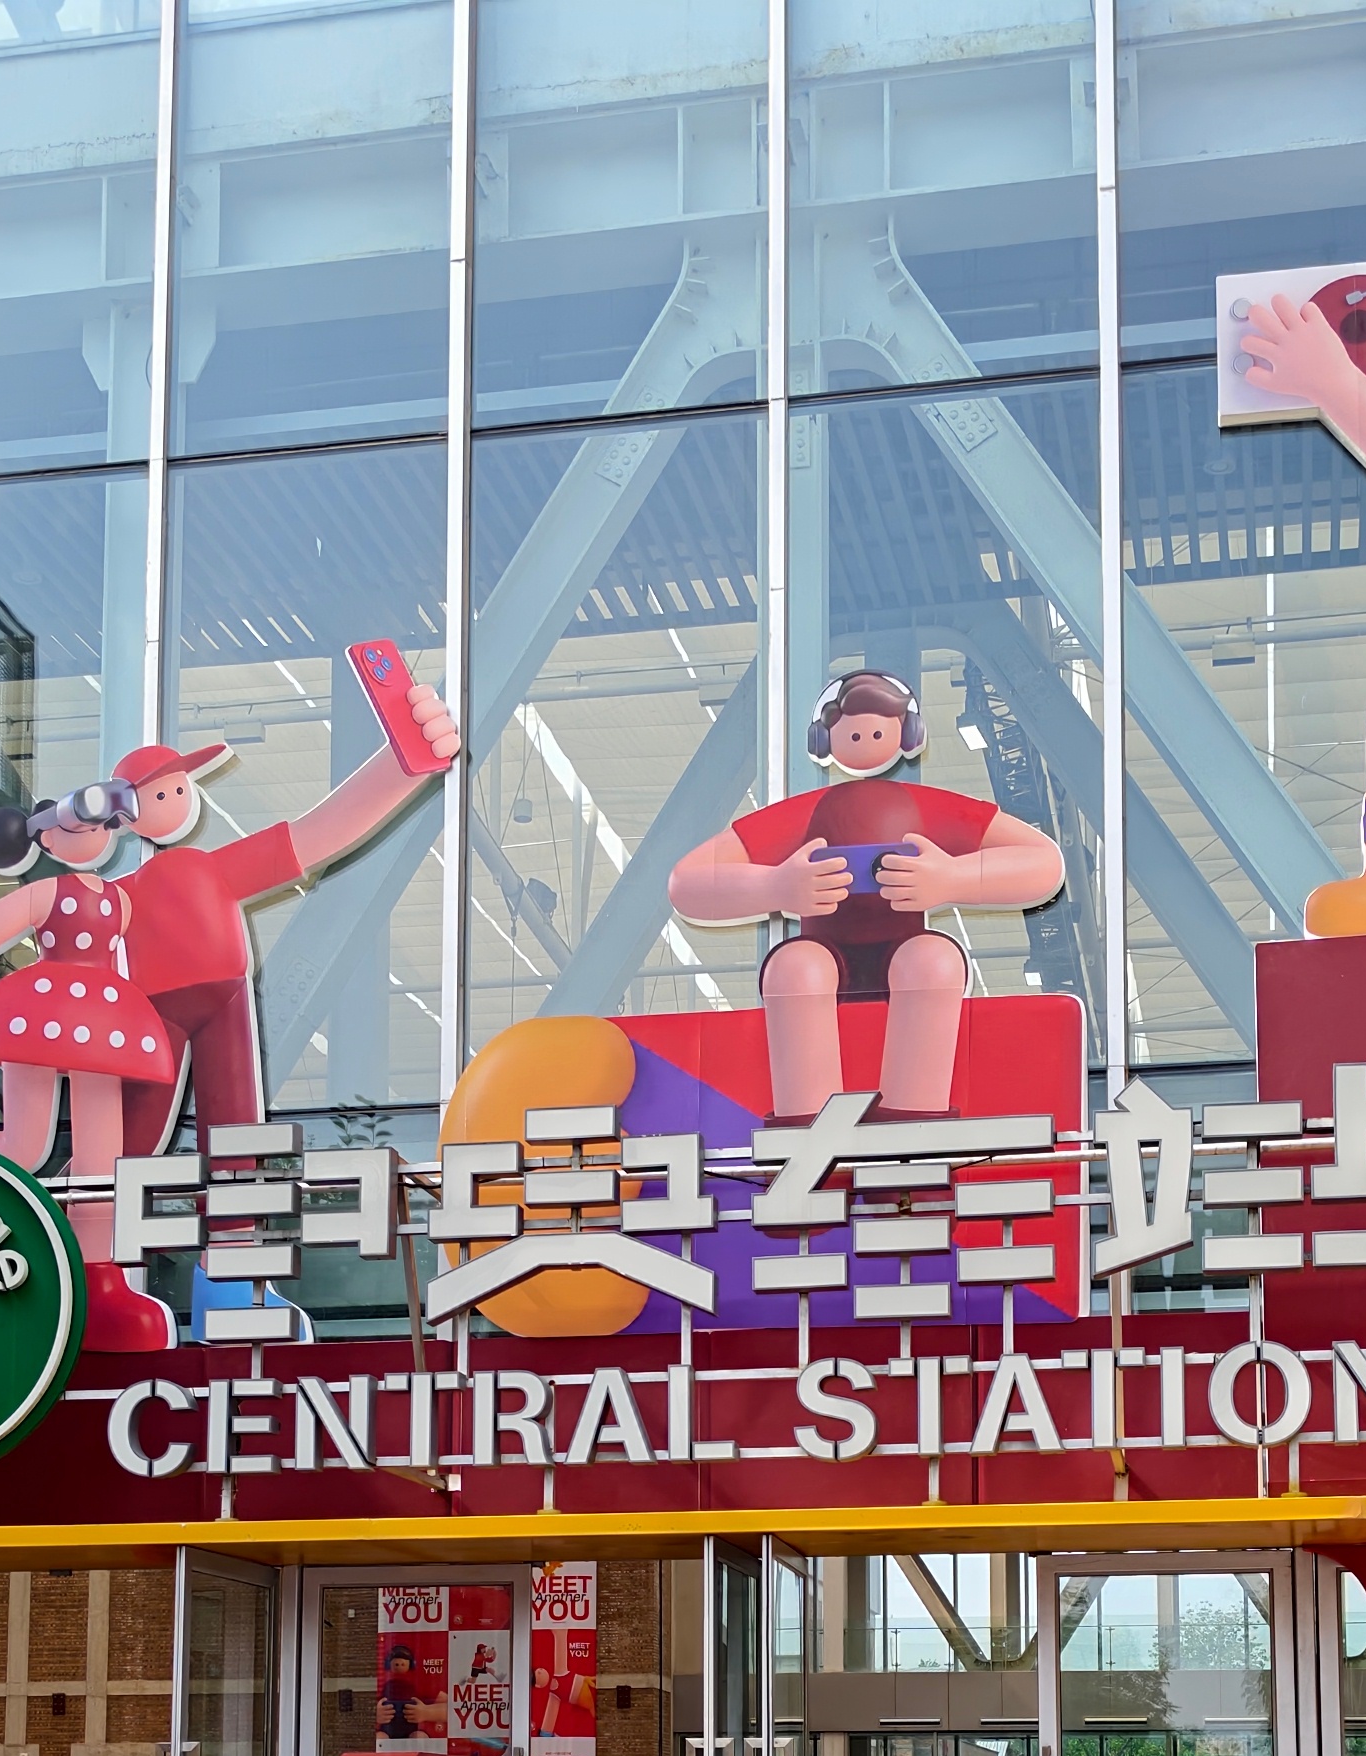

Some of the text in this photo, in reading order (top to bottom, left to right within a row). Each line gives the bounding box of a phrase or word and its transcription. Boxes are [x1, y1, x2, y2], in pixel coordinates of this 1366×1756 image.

[107, 1363, 740, 1479] CENTRAL
[388, 1595, 439, 1605] Another
[535, 1592, 586, 1602] Another
[383, 1602, 443, 1624] YOU
[532, 1599, 590, 1621] YOU
[569, 1642, 591, 1650] MEET
[569, 1650, 589, 1658] YOU
[423, 1658, 444, 1666] MEET
[423, 1666, 443, 1674] YOU
